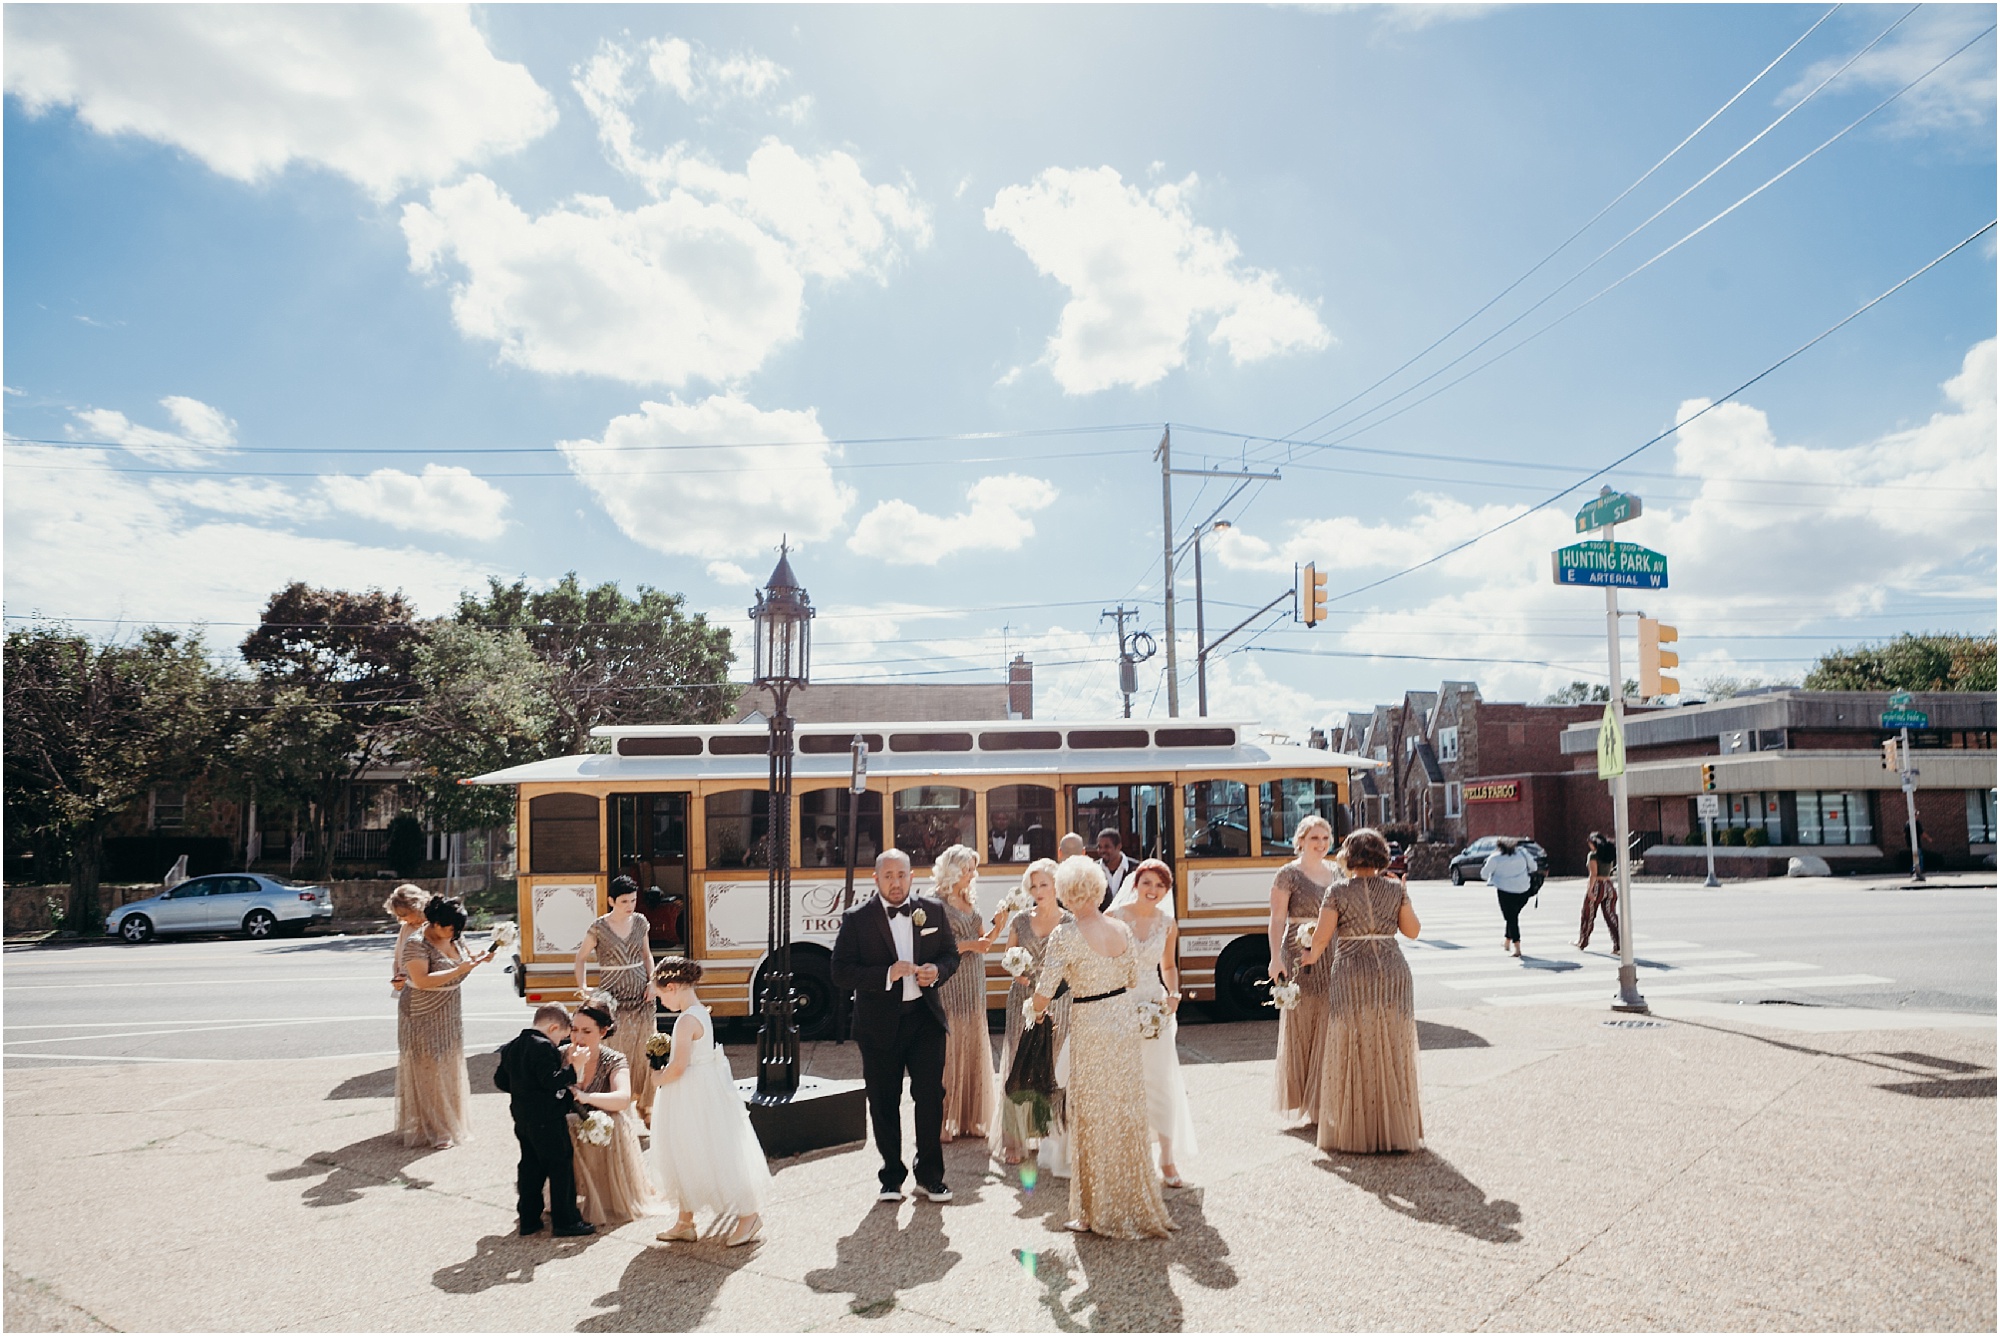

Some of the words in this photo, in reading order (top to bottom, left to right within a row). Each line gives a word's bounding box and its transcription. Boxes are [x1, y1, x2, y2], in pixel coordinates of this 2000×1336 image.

[1591, 511, 1598, 527] L
[1614, 504, 1626, 520] ST
[1562, 550, 1616, 570] HUNTING
[1620, 553, 1650, 572] PARK
[1652, 561, 1664, 573] AV
[1567, 568, 1576, 582] E
[1590, 572, 1638, 585] ARTERIAL
[1650, 574, 1660, 587] W
[1463, 786, 1487, 799] WELLS
[1488, 784, 1515, 799] FARGO
[802, 919, 842, 931] TRO
